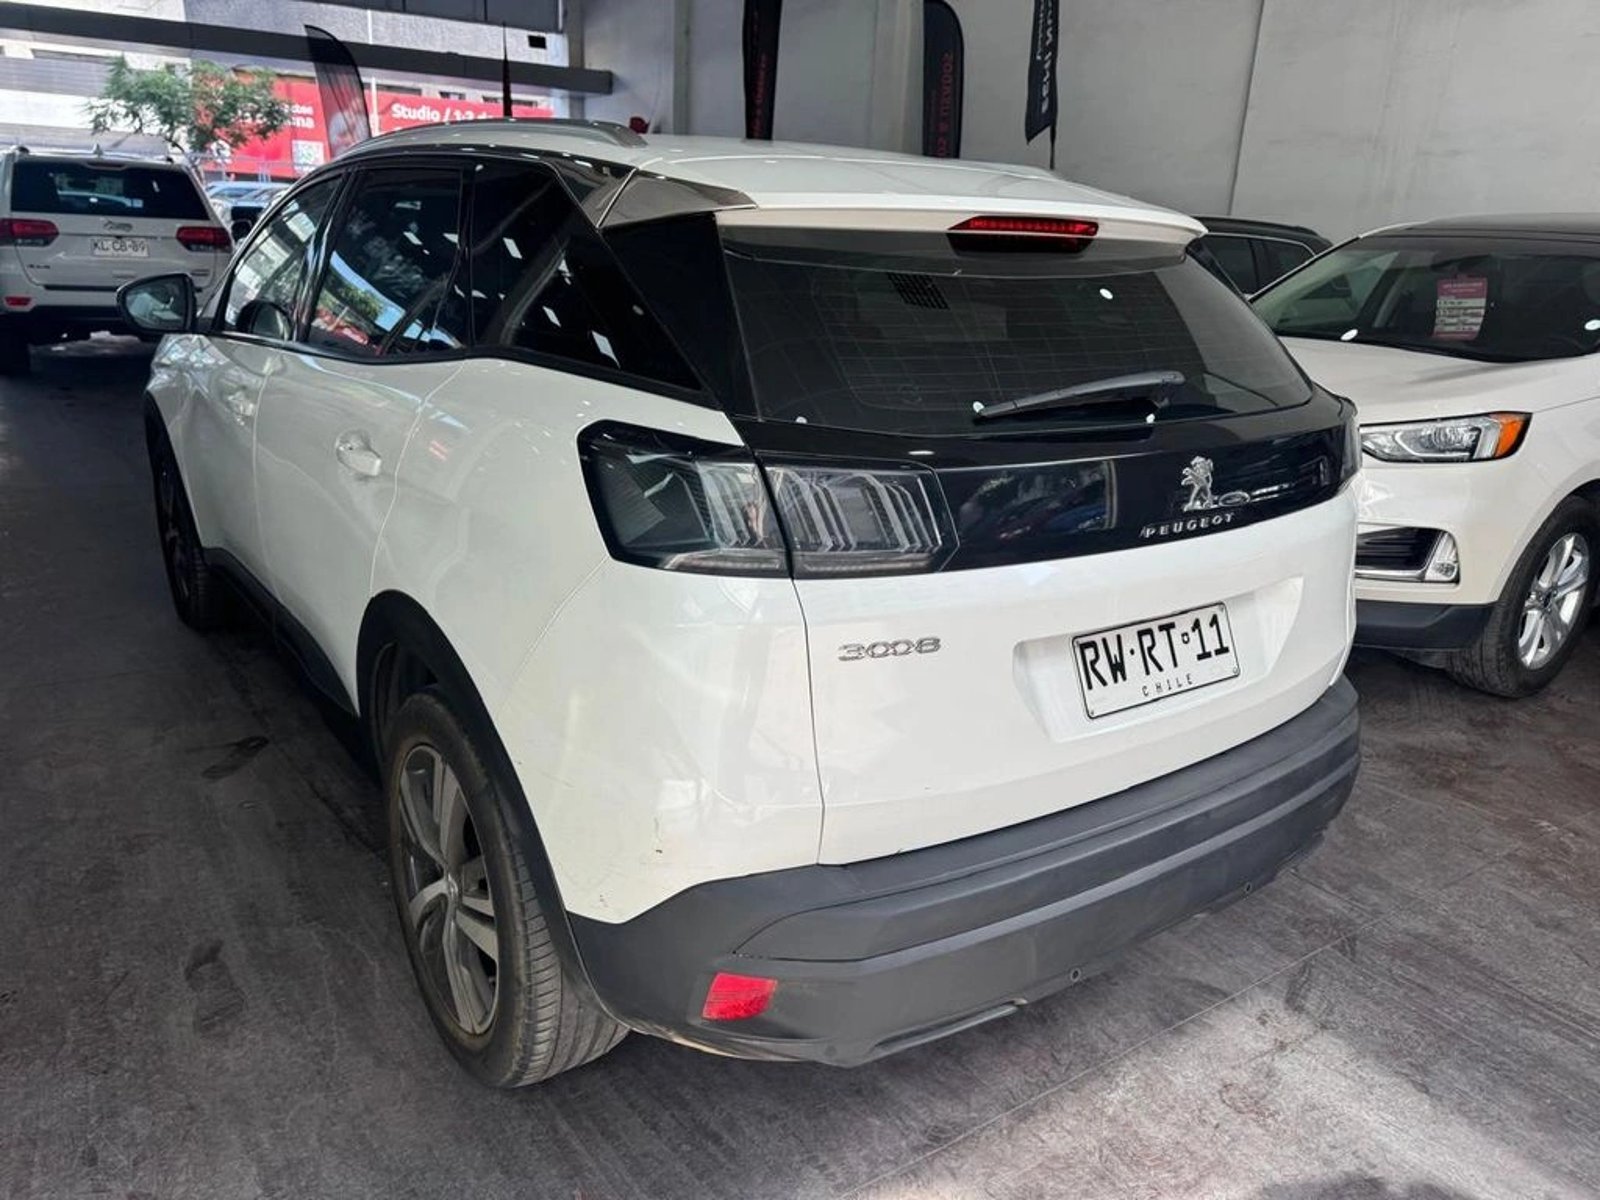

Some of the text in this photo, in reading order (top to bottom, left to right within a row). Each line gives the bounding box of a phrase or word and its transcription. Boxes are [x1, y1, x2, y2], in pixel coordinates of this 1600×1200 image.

[391, 103, 440, 122] Studio
[1140, 512, 1235, 538] PEUGEOT
[838, 637, 942, 661] 3008
[1141, 673, 1194, 697] CHILE
